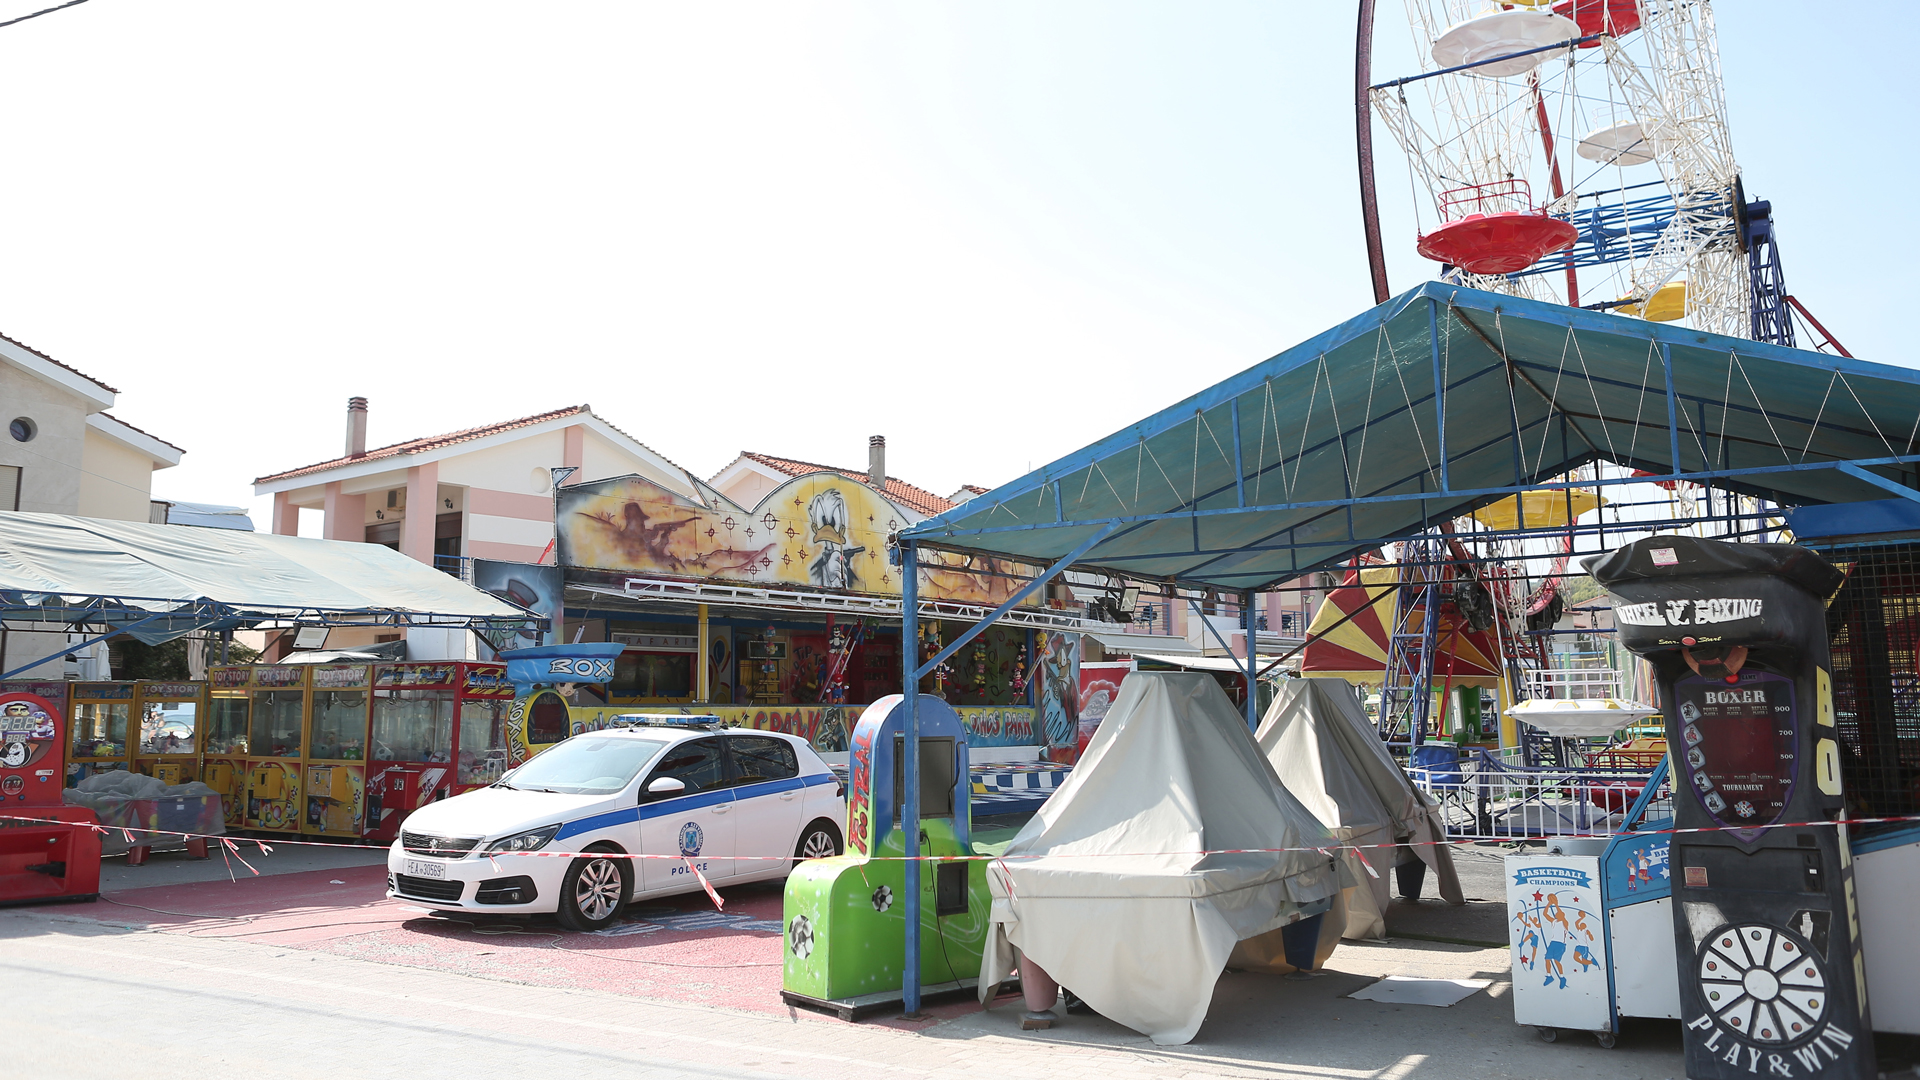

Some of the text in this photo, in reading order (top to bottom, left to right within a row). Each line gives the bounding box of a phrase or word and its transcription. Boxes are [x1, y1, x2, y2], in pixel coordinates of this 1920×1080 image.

[1615, 602, 1667, 627] WHEEL
[1693, 597, 1763, 625] BOXING
[626, 637, 689, 646] SAFARI
[213, 669, 251, 682] TOY STORY
[256, 668, 302, 681] TOY STORY
[318, 668, 366, 682] TOY STORY
[36, 686, 59, 696] BOX
[76, 688, 133, 699] Baby Party
[143, 685, 201, 694] TOY STORY
[1704, 690, 1767, 704] BOXER
[1004, 711, 1034, 742] PARK
[1722, 784, 1764, 792] TOURNAMENT
[423, 863, 442, 877] 30569
[671, 862, 708, 876] POLCE
[1520, 868, 1583, 880] BASKETBALL
[1529, 879, 1576, 887] CHAMPIONS
